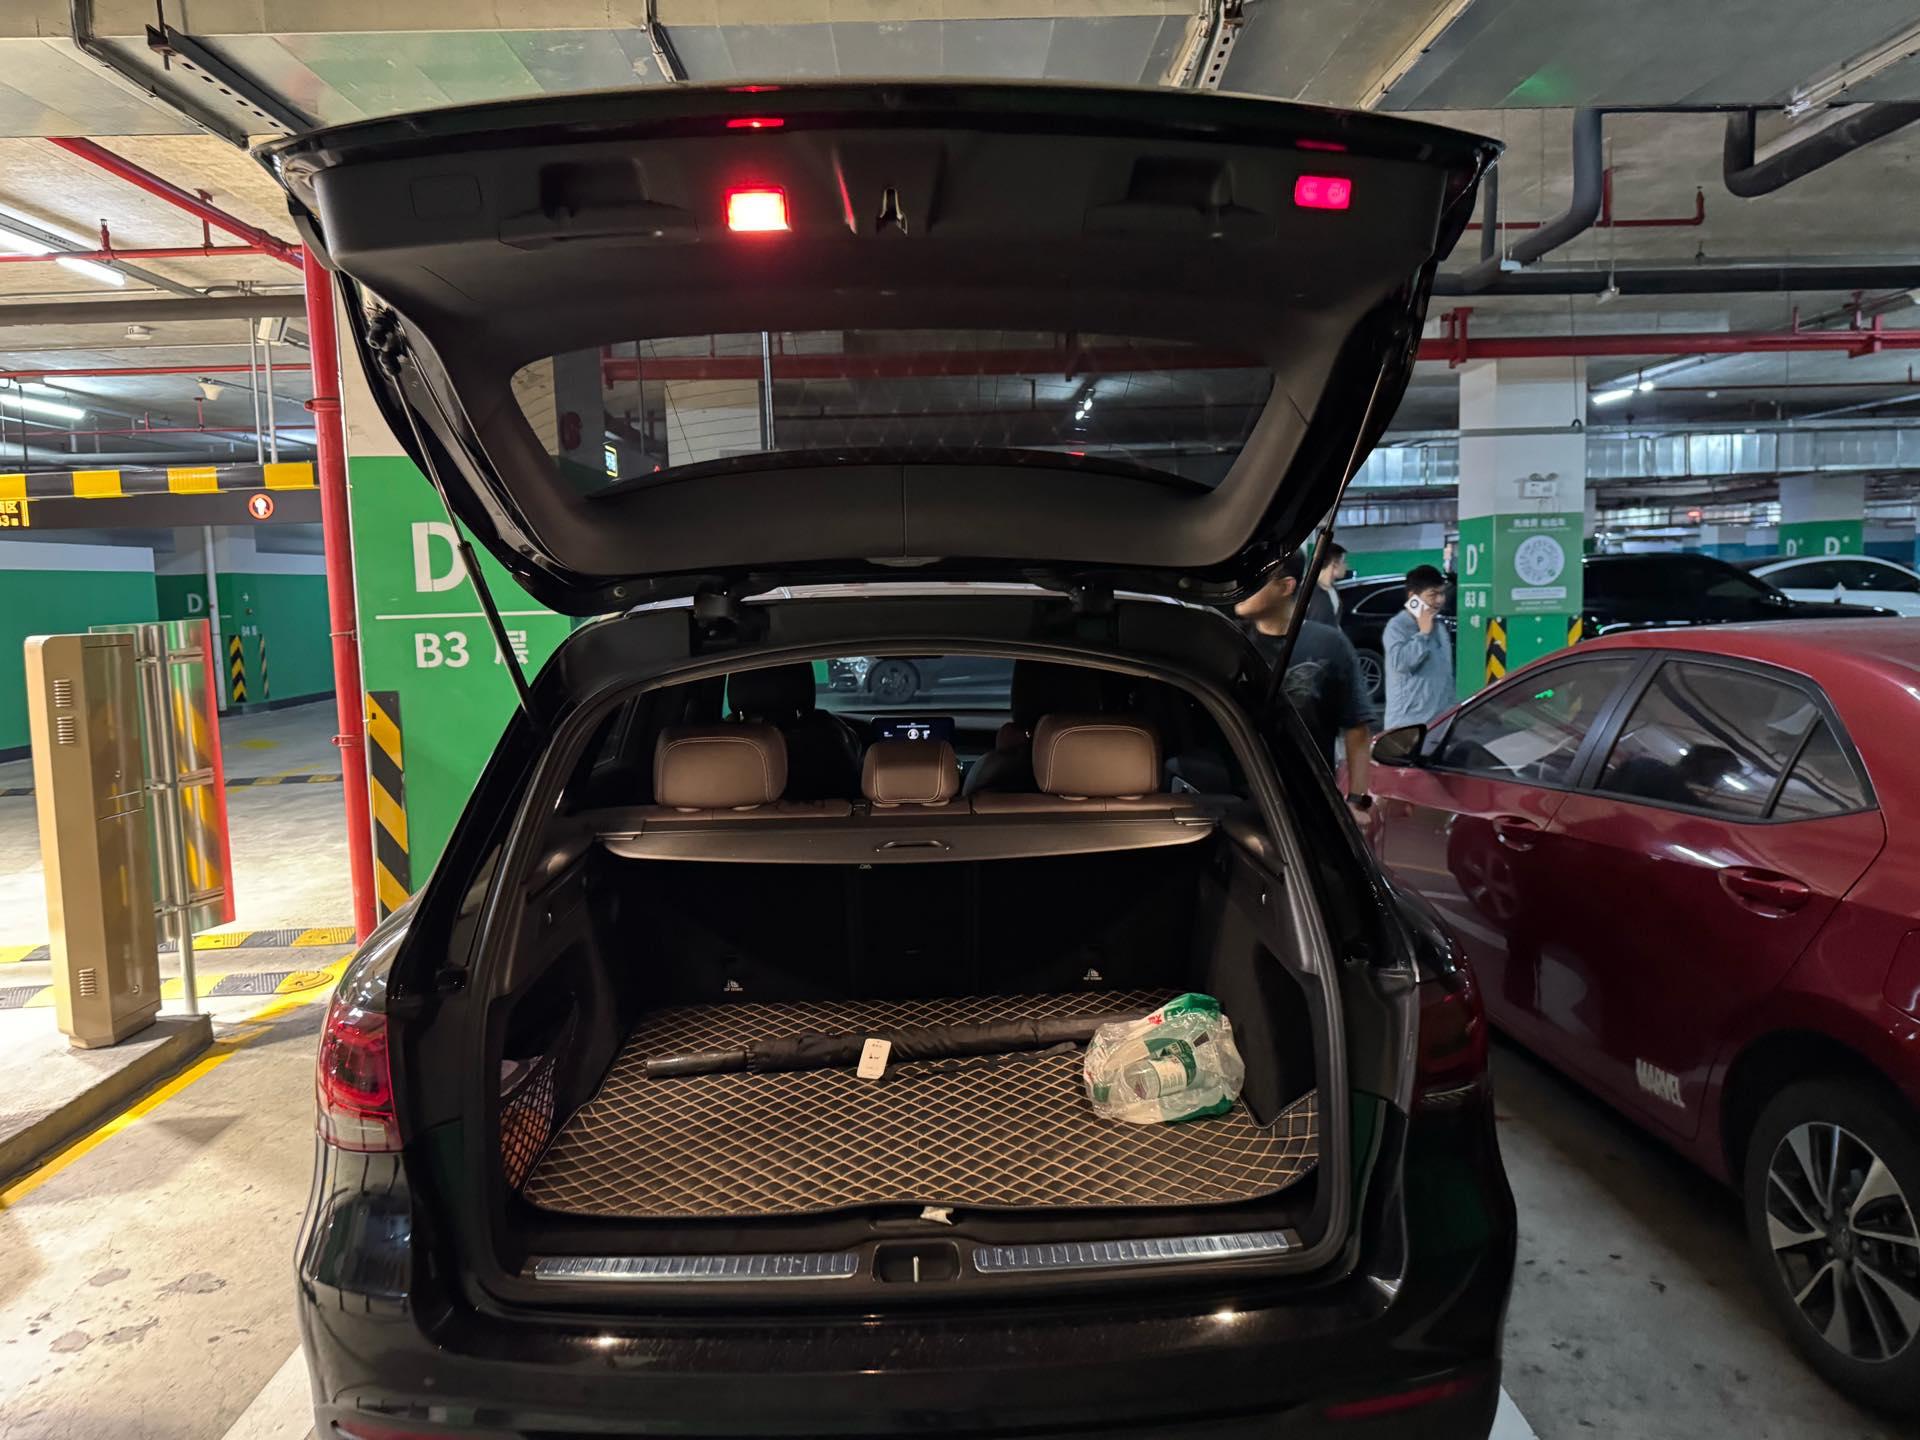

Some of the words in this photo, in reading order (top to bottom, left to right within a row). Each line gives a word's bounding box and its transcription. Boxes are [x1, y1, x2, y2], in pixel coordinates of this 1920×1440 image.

[411, 521, 467, 593] D
[1466, 544, 1478, 576] D
[1825, 536, 1840, 556] D
[187, 593, 204, 613] D
[414, 631, 470, 669] B3
[1636, 1057, 1686, 1108] MARVEL
